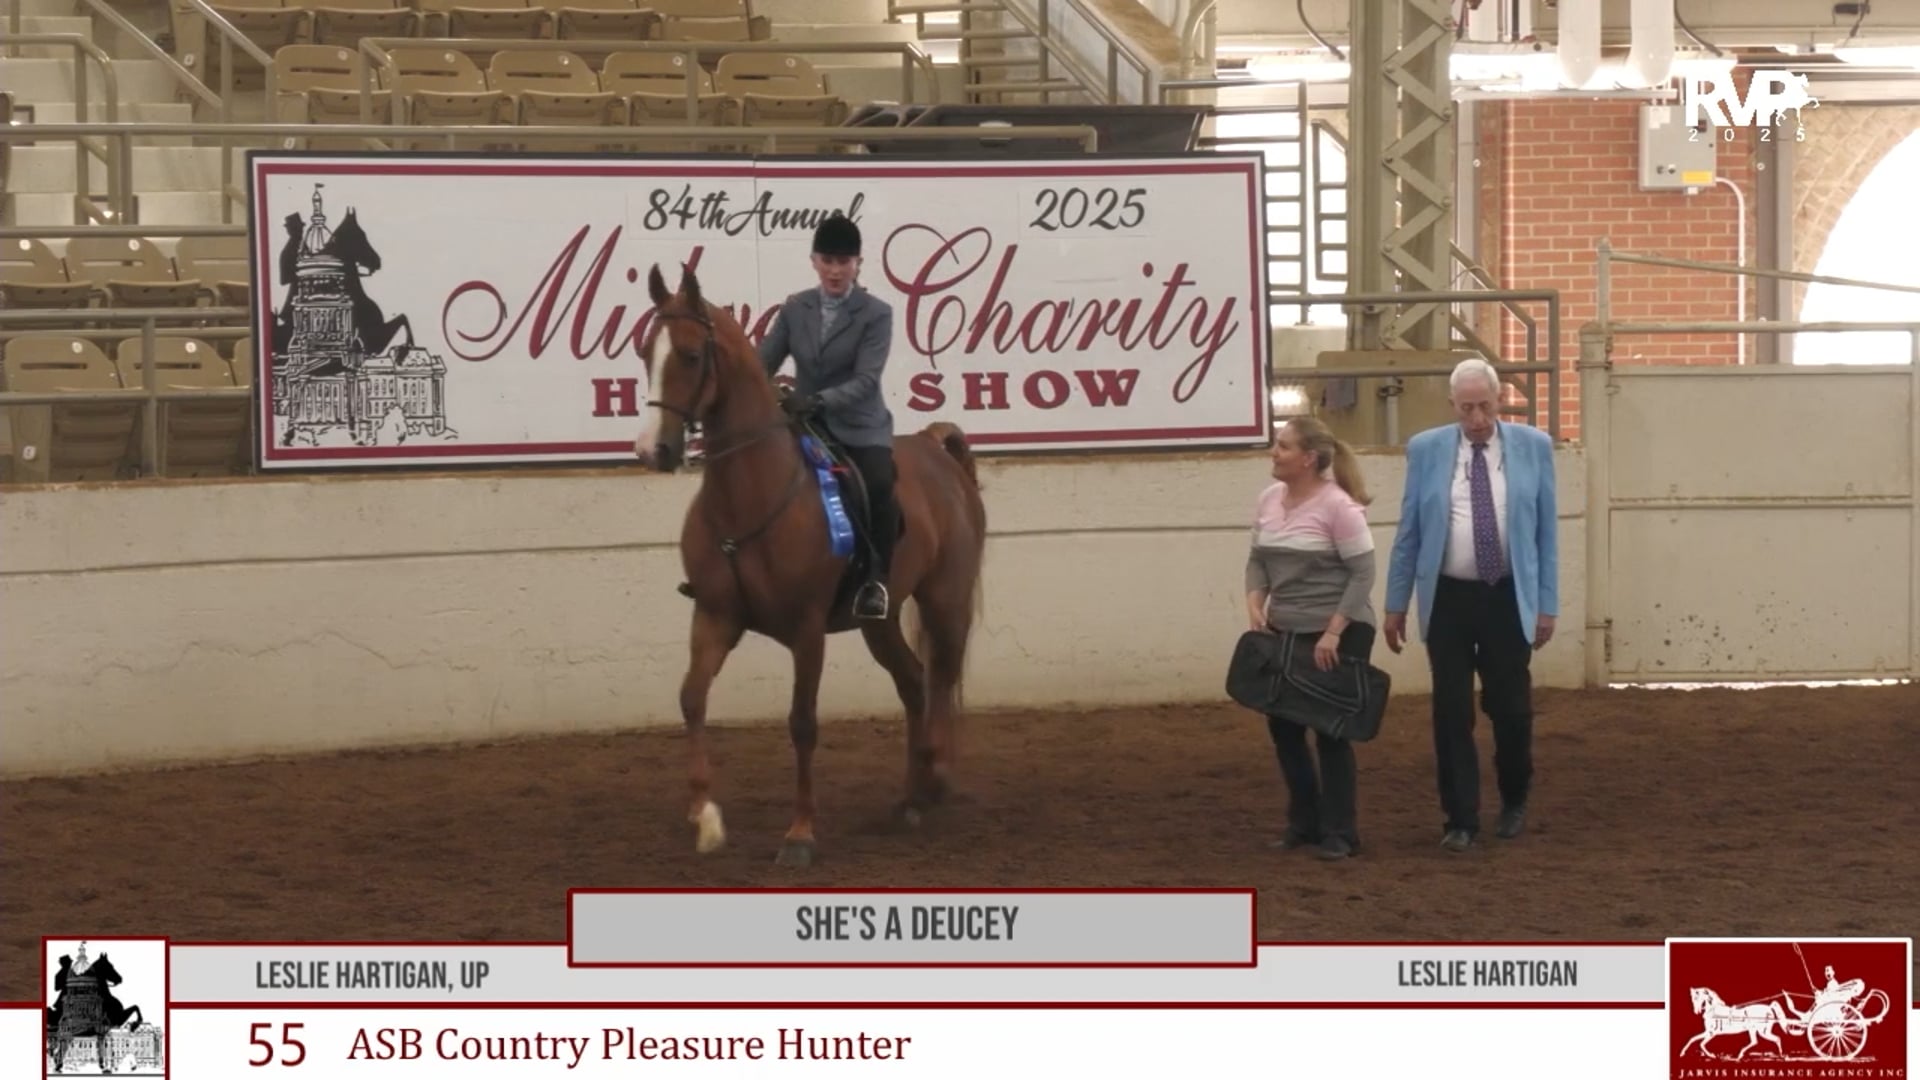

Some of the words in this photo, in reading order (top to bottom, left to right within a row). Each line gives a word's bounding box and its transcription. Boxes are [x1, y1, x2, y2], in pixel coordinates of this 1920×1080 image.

[724, 190, 865, 237] Annul
[1029, 187, 1147, 232] 2025
[882, 223, 1239, 403] Charity
[906, 368, 1141, 412] SHOW
